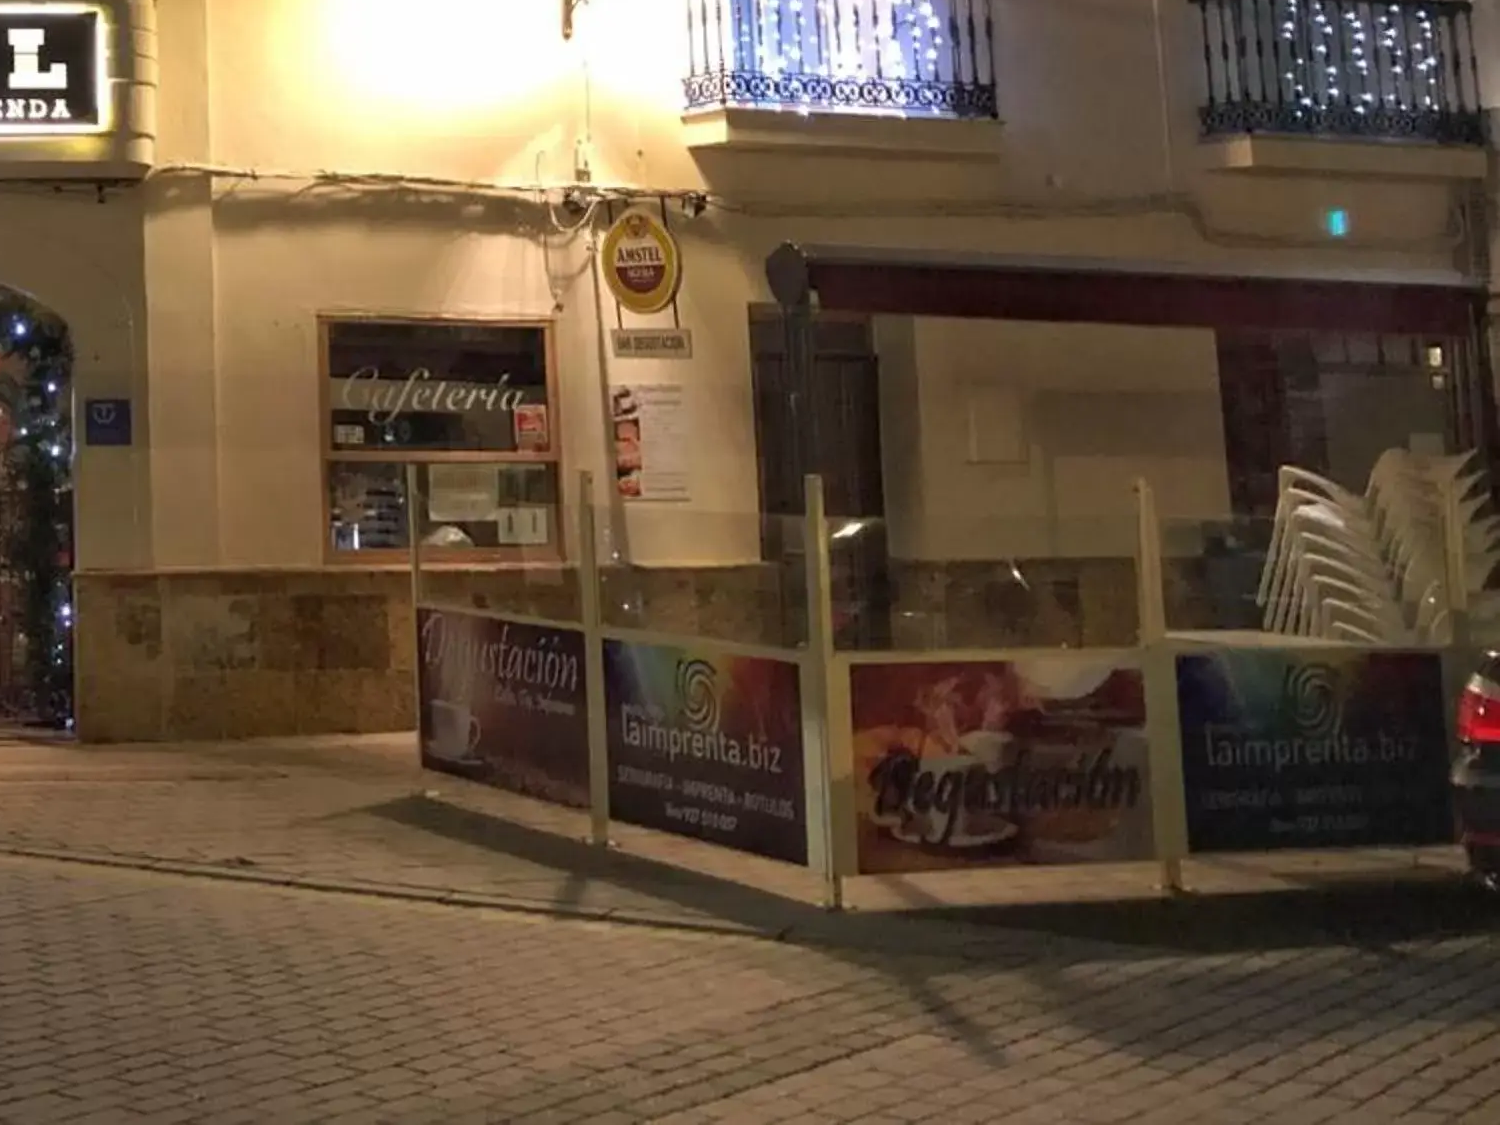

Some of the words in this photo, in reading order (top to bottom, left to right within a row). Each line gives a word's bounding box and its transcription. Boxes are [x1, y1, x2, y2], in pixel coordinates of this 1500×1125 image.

[616, 246, 662, 264] AMSTEL
[343, 367, 527, 425] Cafetería
[621, 703, 784, 774] laimprenta.biz
